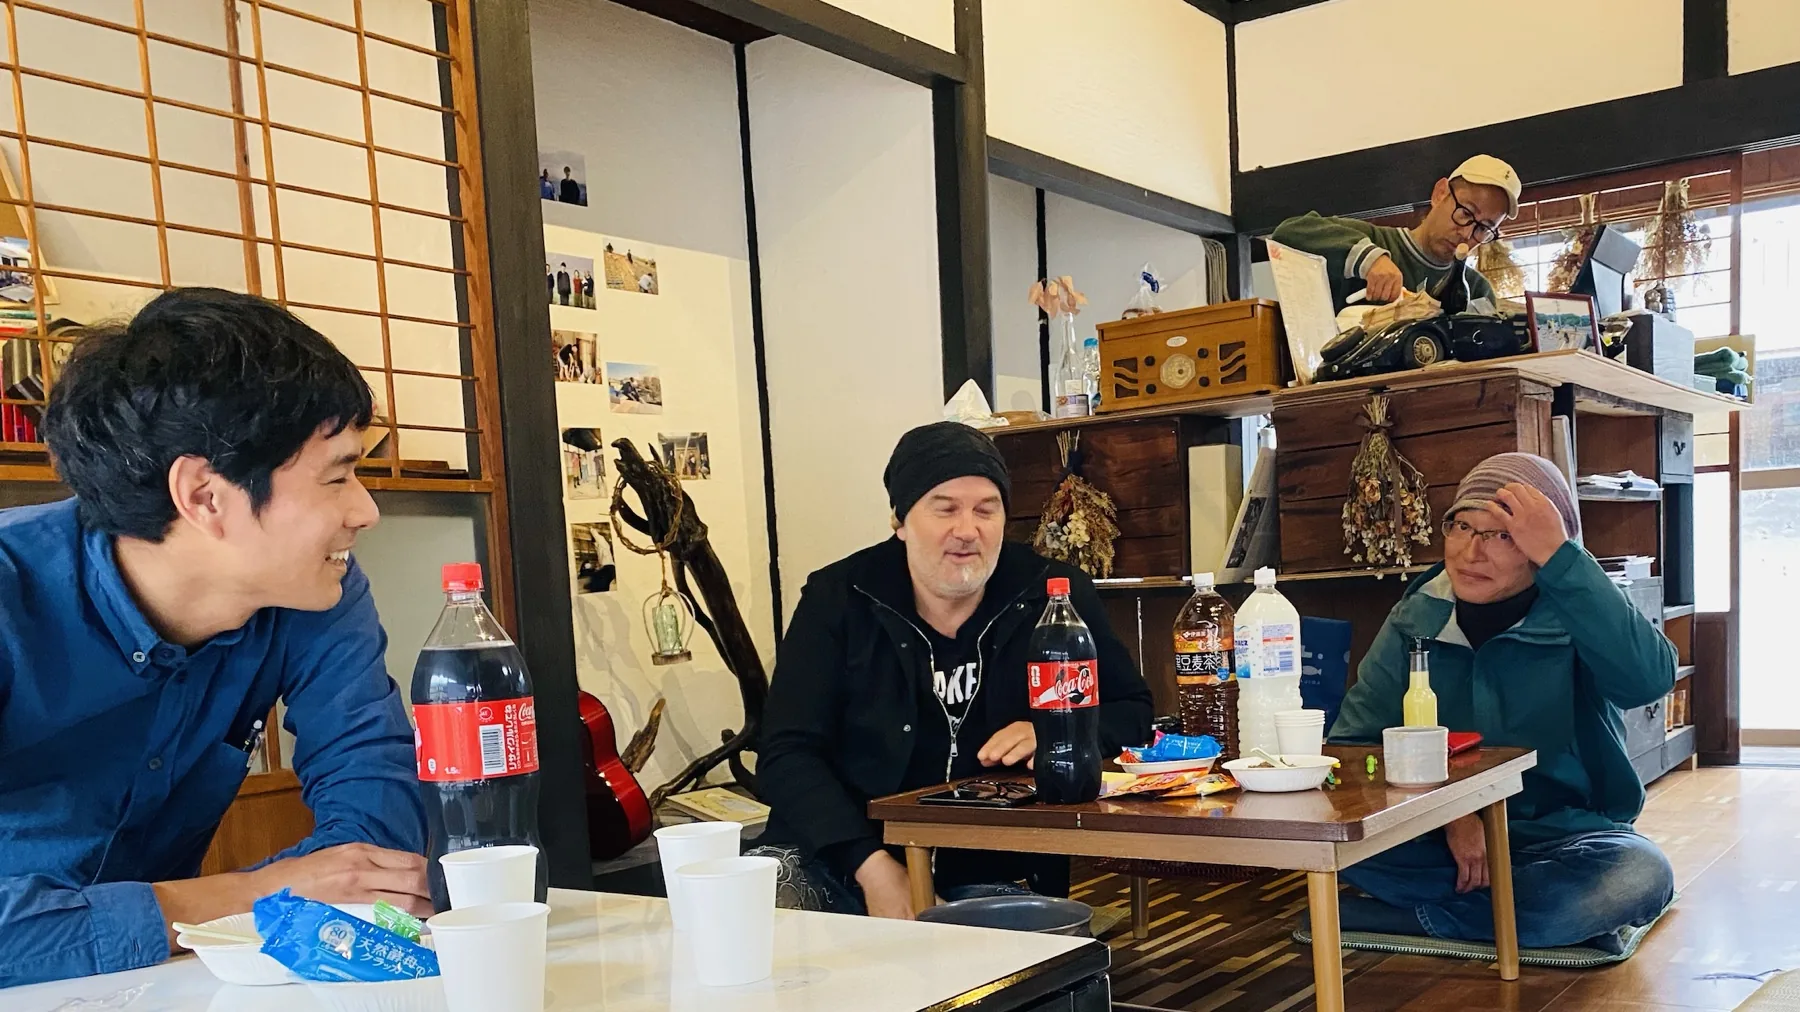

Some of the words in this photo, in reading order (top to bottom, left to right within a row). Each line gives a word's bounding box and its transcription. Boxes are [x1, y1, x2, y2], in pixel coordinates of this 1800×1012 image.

[505, 704, 517, 770] リサイクルしてね
[330, 927, 347, 940] 80
